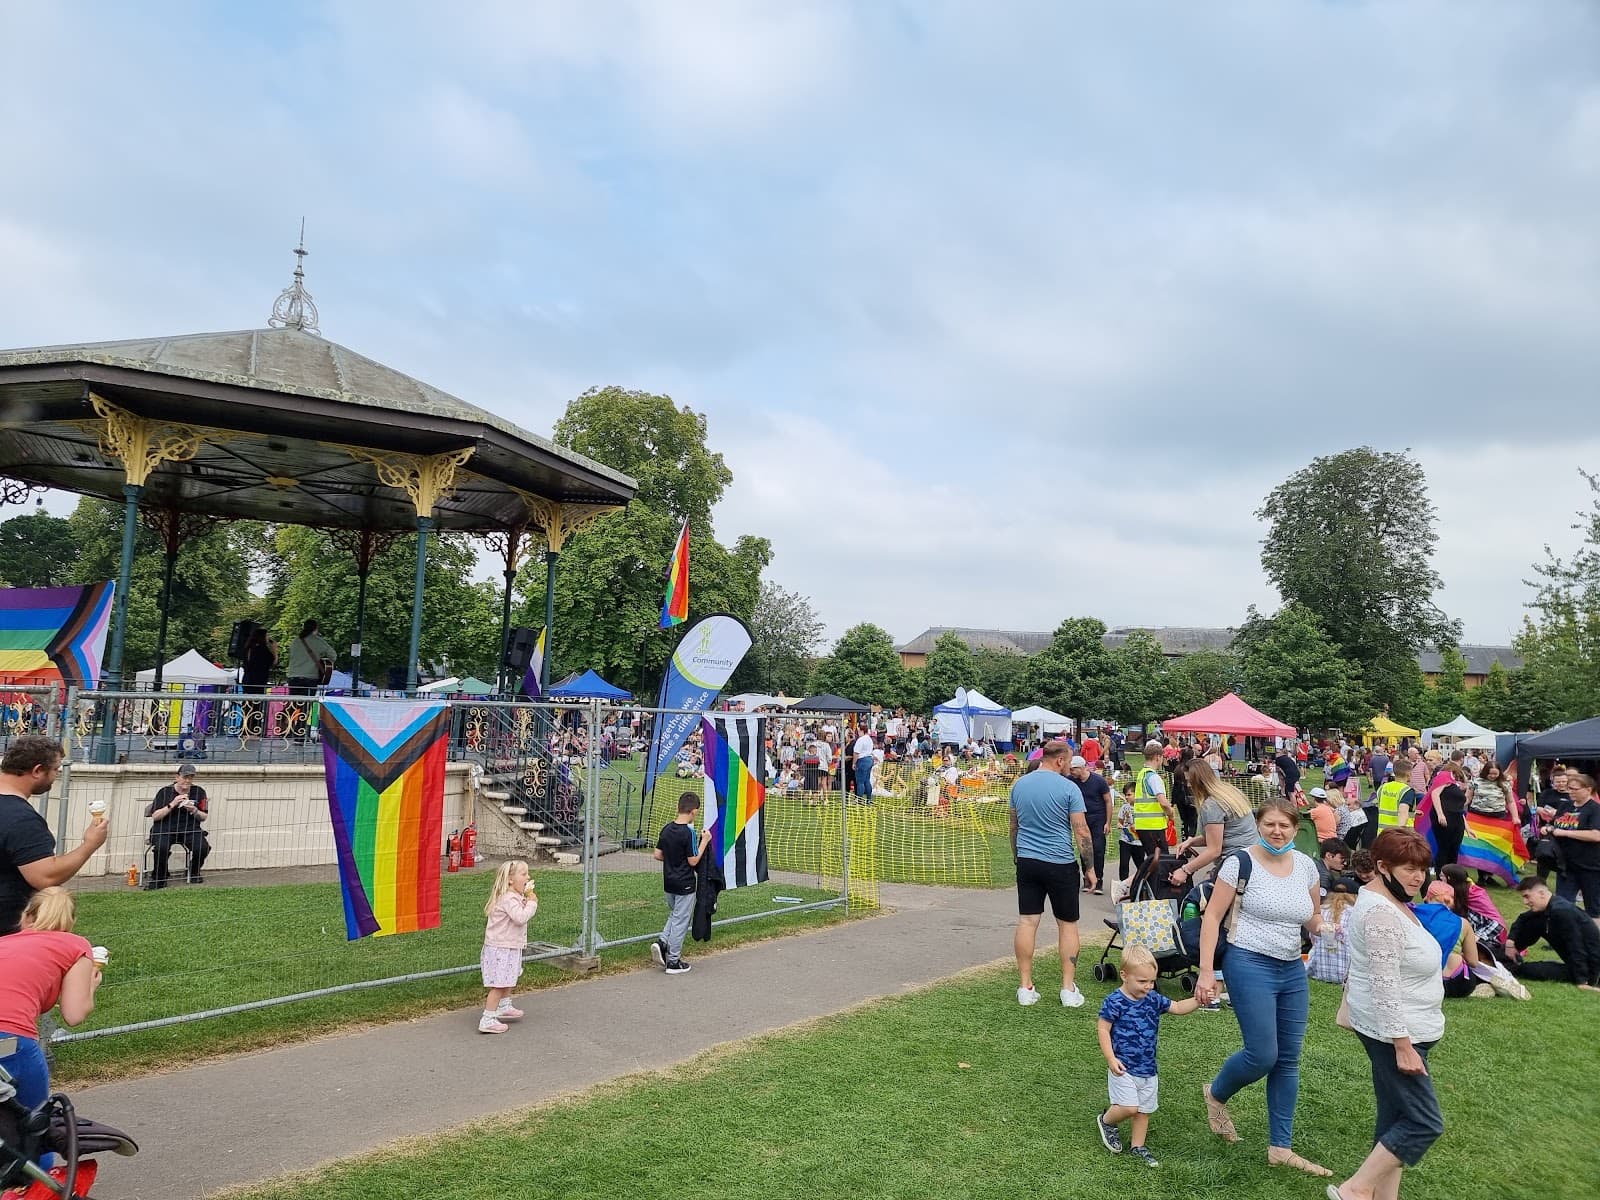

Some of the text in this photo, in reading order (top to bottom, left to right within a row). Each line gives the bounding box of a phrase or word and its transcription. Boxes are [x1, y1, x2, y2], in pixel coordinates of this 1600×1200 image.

[692, 656, 734, 667] Community
[654, 696, 694, 746] Togethe we
[678, 690, 709, 733] diffeence
